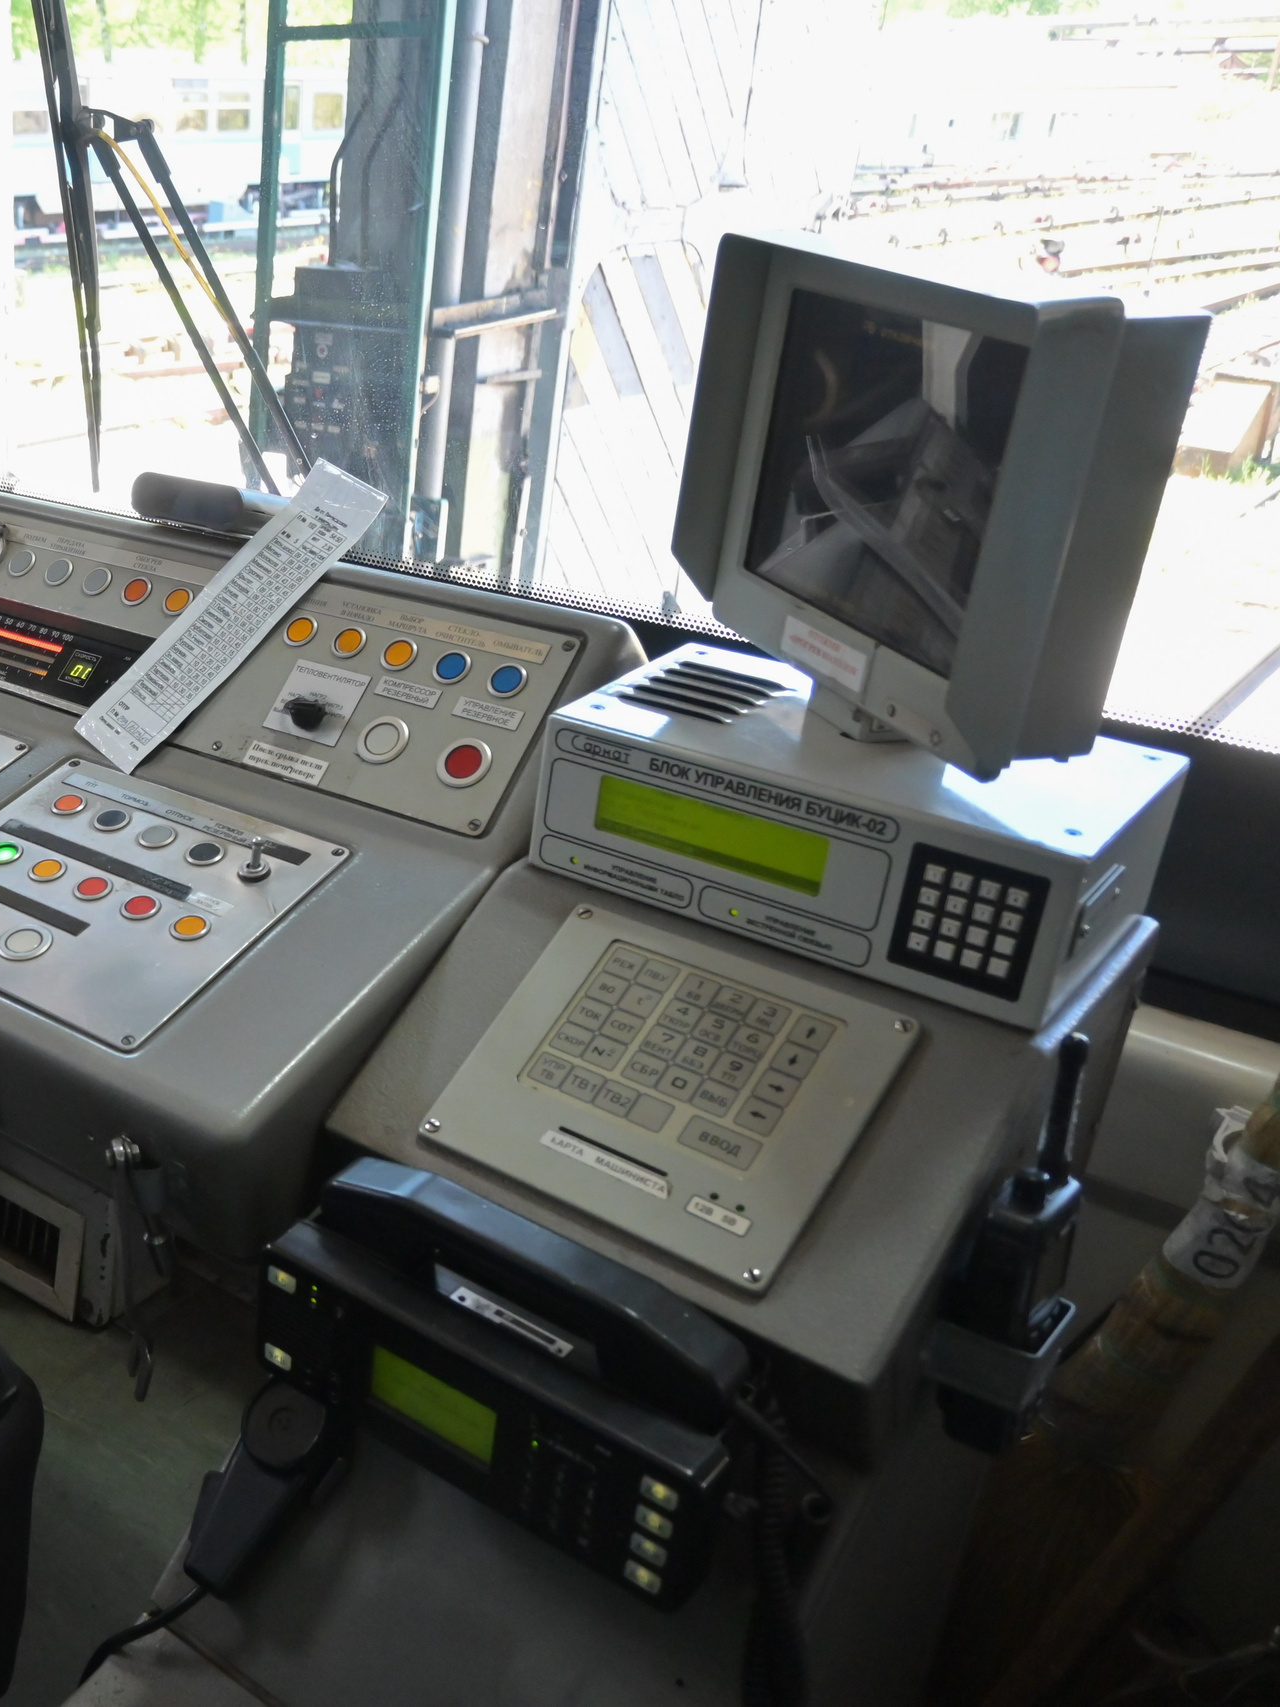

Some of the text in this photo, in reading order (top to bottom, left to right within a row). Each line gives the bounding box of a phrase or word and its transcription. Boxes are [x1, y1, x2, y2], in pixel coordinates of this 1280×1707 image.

[342, 600, 382, 616] УСТАНОВКА
[400, 614, 424, 624] ВЫБОР
[388, 620, 427, 635] МАРШРУТА
[436, 631, 486, 648] ОЧИСТИТЕЛЬ
[493, 639, 543, 657] ОМЫВАТЕЛЬ
[75, 652, 97, 662] СКОРОСТЬ
[295, 665, 366, 688] ТЕПЛОВЕНТИЛЯТОР
[382, 686, 430, 705] РЕЗЕРВНЫЙ
[383, 679, 437, 697] КОМПРЕССОР
[462, 708, 510, 726] РЕЗЕРВНОЕ
[464, 700, 516, 719] УПРАВЛЕНИЕ
[252, 743, 275, 756] После
[275, 752, 299, 764] срыва
[121, 794, 149, 806] ТОРМОЗ
[649, 757, 691, 780] БЛОК
[695, 768, 803, 812] УПРАВЛЕНИЯ
[805, 799, 888, 836] БУЦИК-02
[165, 809, 195, 822] ОТПУСК
[214, 822, 244, 835] ТОРМОЗ
[612, 957, 636, 971] РЕЖ
[644, 969, 668, 982] ПВУ
[580, 1007, 603, 1021] ТОК
[610, 1020, 635, 1034] СОТ
[557, 1032, 586, 1047] СКОР
[542, 1058, 566, 1070] УПР
[631, 1062, 659, 1077] СБР
[571, 1075, 597, 1093] ТВ1
[671, 1077, 687, 1090] 0
[604, 1089, 631, 1107] ТВ2
[699, 1090, 727, 1108] ВЫБ
[698, 1131, 742, 1157] ВВОД
[595, 1156, 666, 1193] МАШИНИСТА
